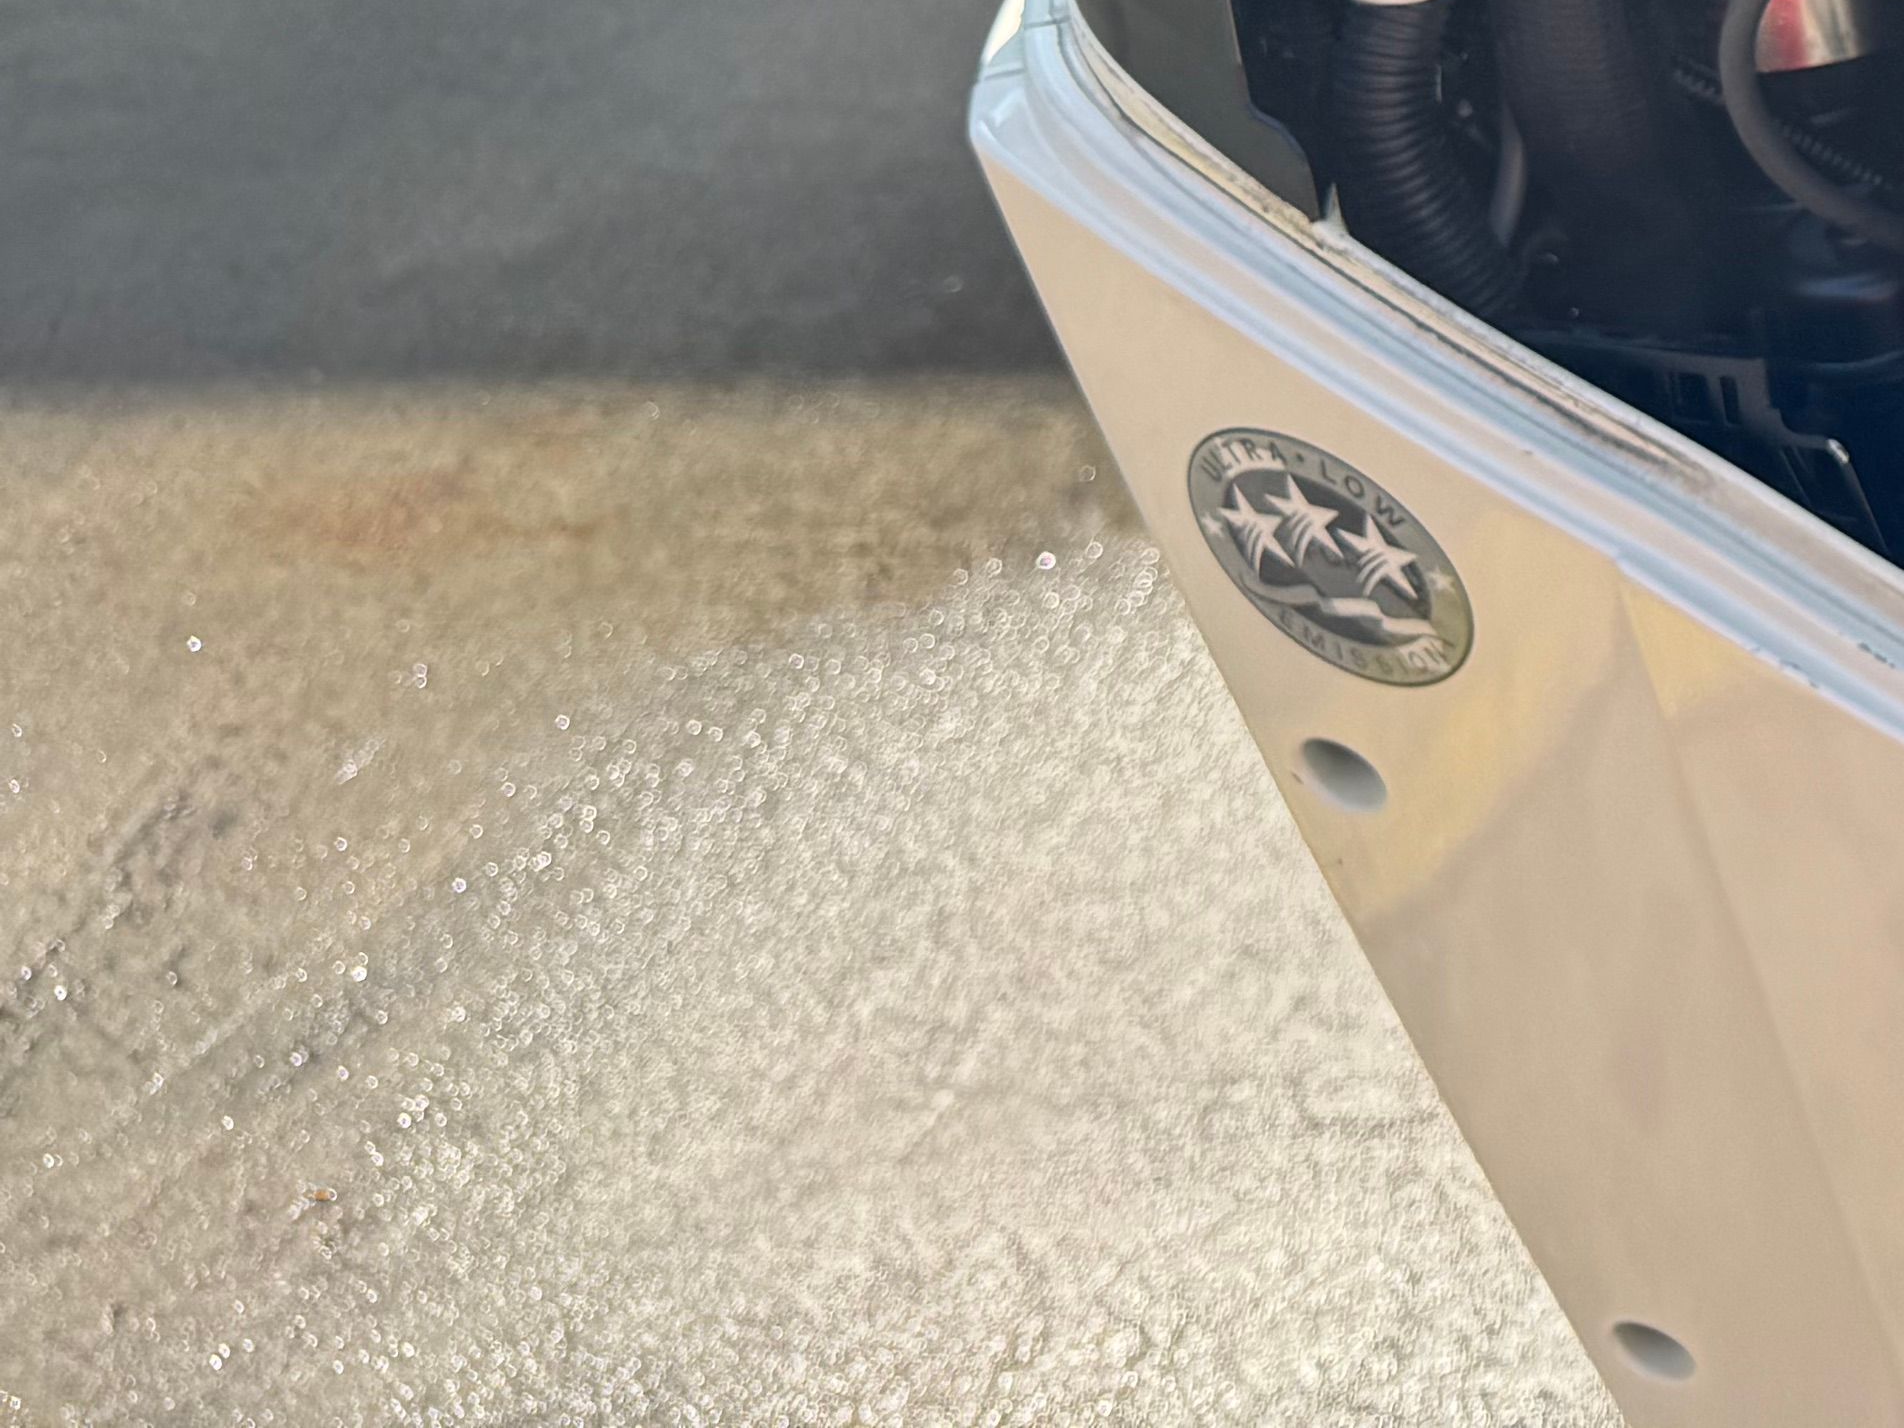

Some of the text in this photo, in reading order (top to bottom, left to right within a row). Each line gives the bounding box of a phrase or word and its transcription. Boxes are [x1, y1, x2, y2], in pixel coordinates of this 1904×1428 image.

[1199, 438, 1407, 529] ULTRA LOW
[1280, 610, 1455, 677] EMISSION
